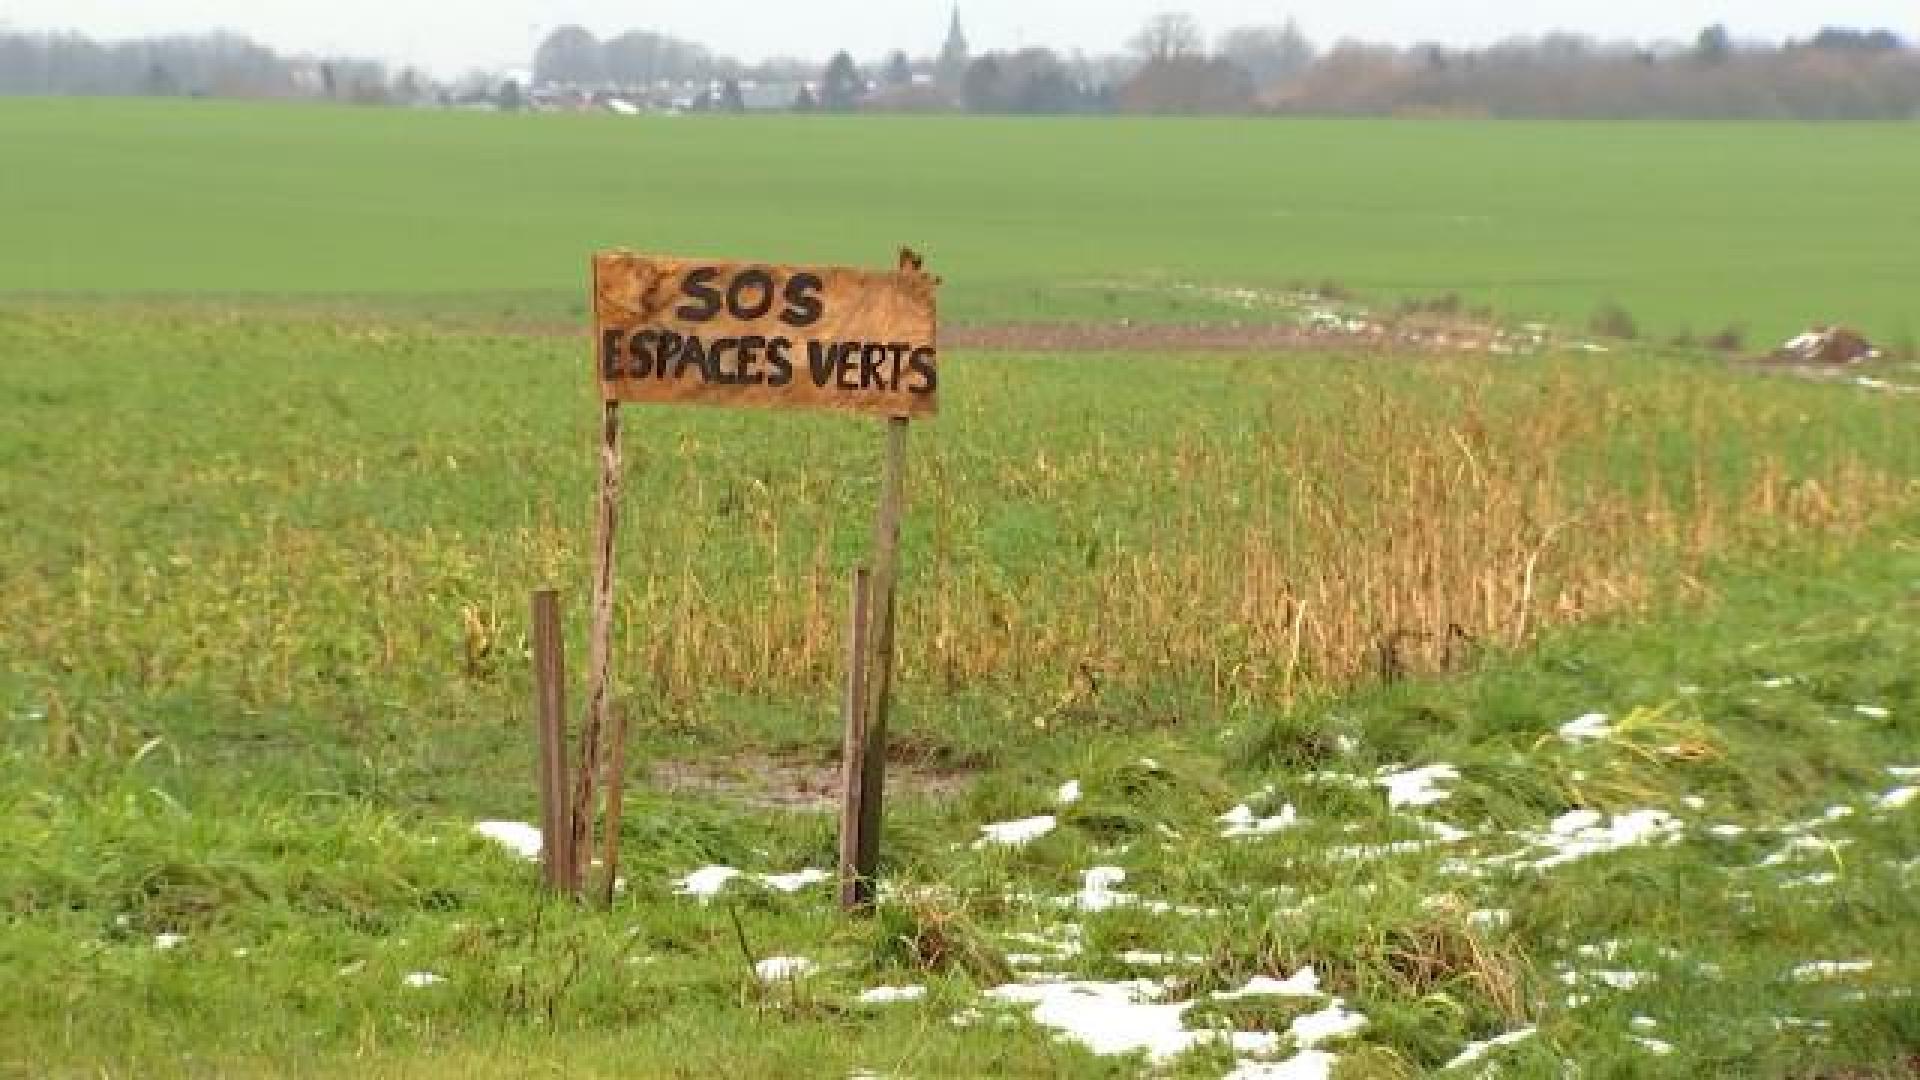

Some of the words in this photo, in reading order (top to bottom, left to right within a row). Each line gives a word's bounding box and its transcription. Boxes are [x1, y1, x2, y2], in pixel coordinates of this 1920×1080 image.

[676, 266, 823, 327] SOS
[602, 329, 793, 388] ESPACES
[806, 340, 937, 394] VERTS
